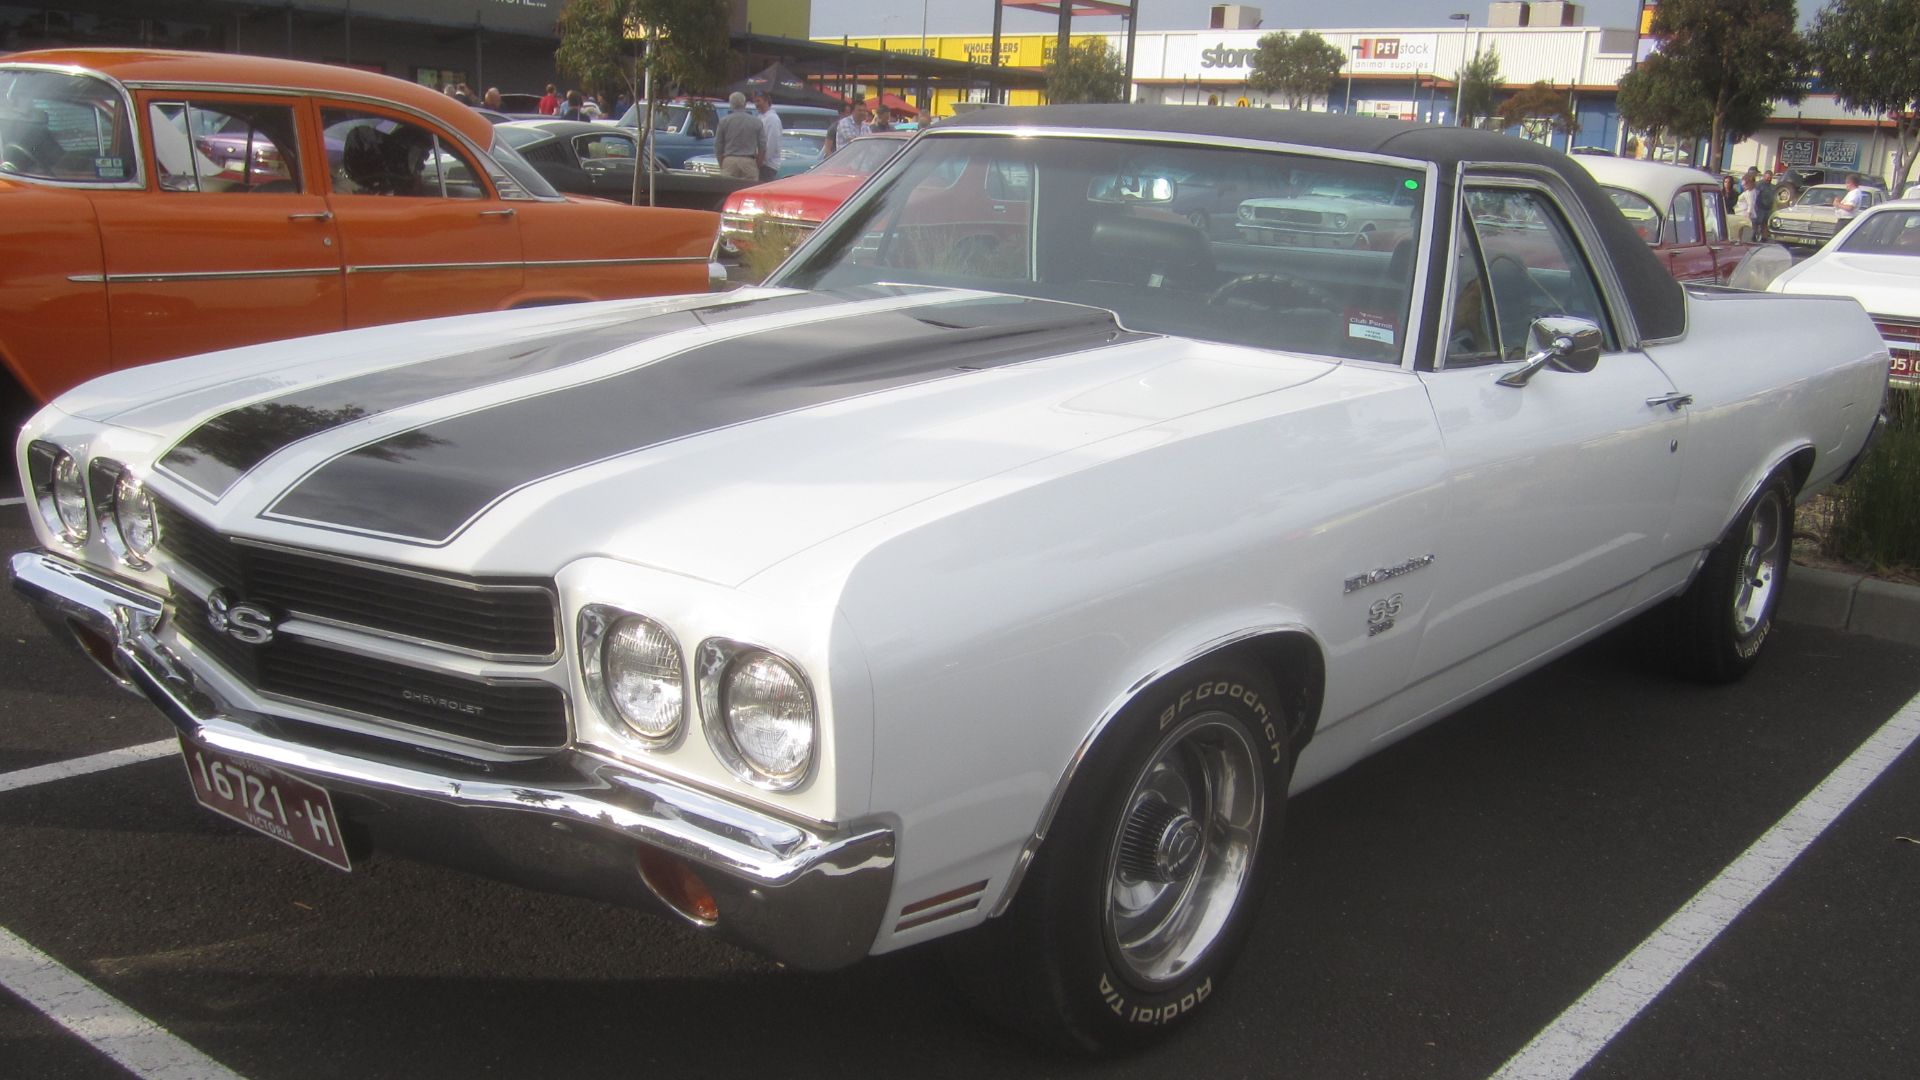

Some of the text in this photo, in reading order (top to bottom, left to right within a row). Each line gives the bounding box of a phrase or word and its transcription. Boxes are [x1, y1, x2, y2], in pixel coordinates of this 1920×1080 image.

[963, 43, 1019, 53] WHOLESLERS
[1376, 42, 1398, 54] PET
[969, 55, 1011, 64] DIRCT
[1391, 61, 1428, 70] supplies
[1785, 142, 1811, 151] GAS
[1368, 593, 1403, 624] SS
[207, 593, 274, 645] SS
[403, 690, 484, 716] CHEVROLET
[245, 811, 295, 843] VICTORIA
[1130, 976, 1212, 1025] Radial
